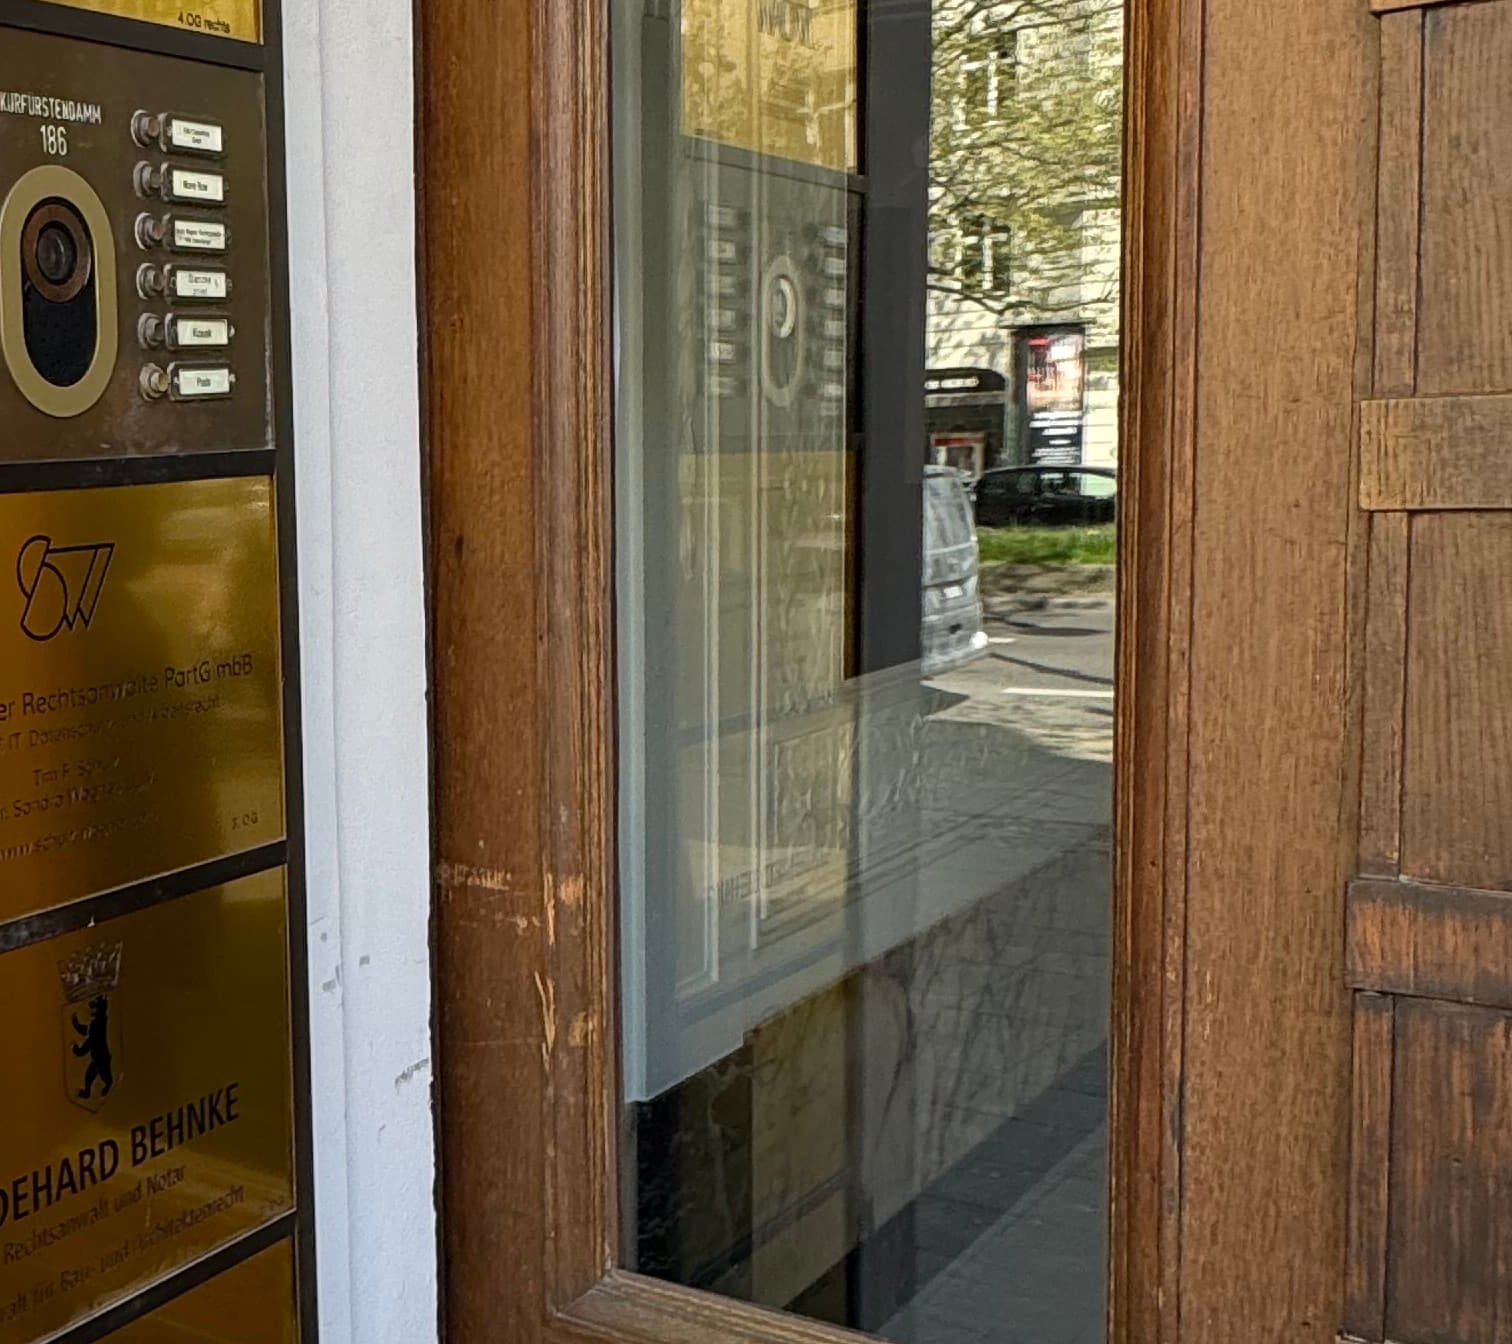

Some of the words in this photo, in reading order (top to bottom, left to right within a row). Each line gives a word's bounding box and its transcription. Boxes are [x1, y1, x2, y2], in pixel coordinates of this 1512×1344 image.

[39, 124, 68, 156] 186
[164, 660, 212, 689] PartG
[215, 653, 254, 679] mbB
[130, 1082, 240, 1168] BEHNKE
